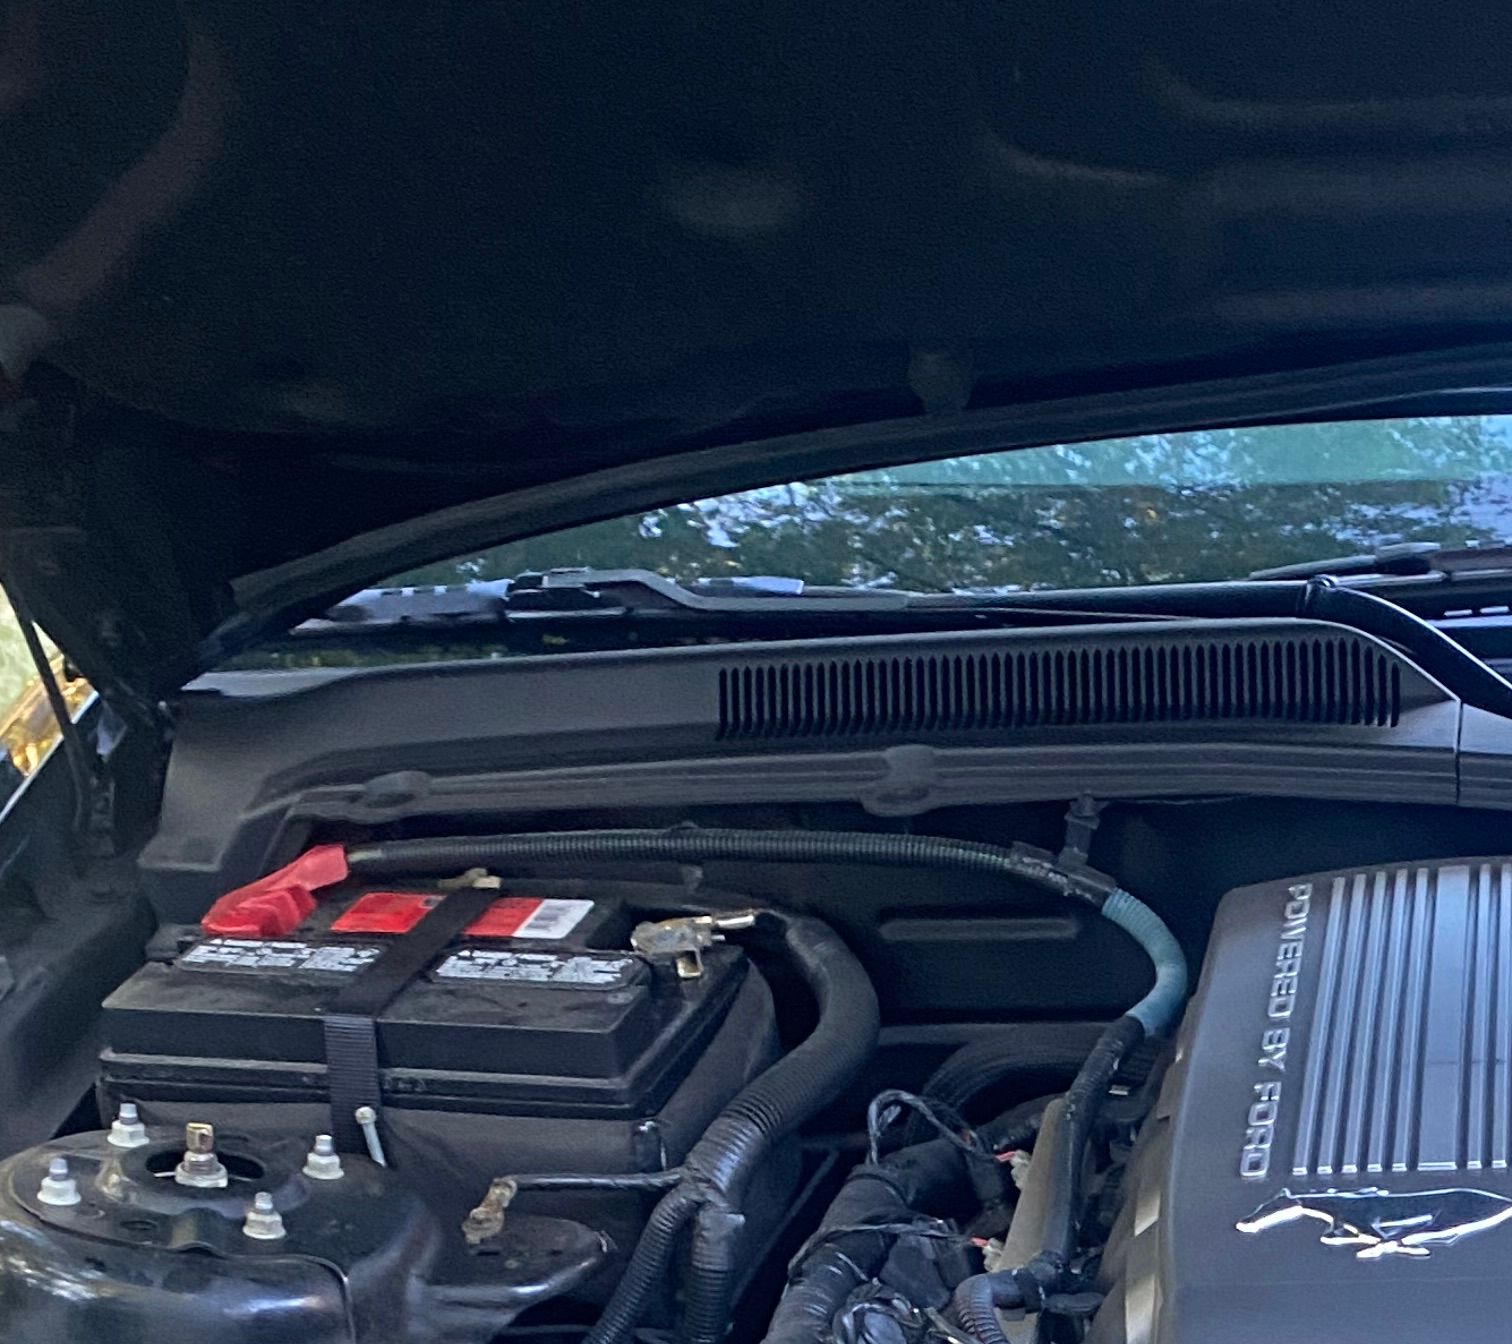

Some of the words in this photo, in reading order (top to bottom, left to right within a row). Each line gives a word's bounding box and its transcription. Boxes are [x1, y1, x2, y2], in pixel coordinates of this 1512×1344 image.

[1267, 882, 1313, 1018] POWERED
[1257, 1027, 1290, 1072] BY
[1240, 1080, 1282, 1178] FORD
